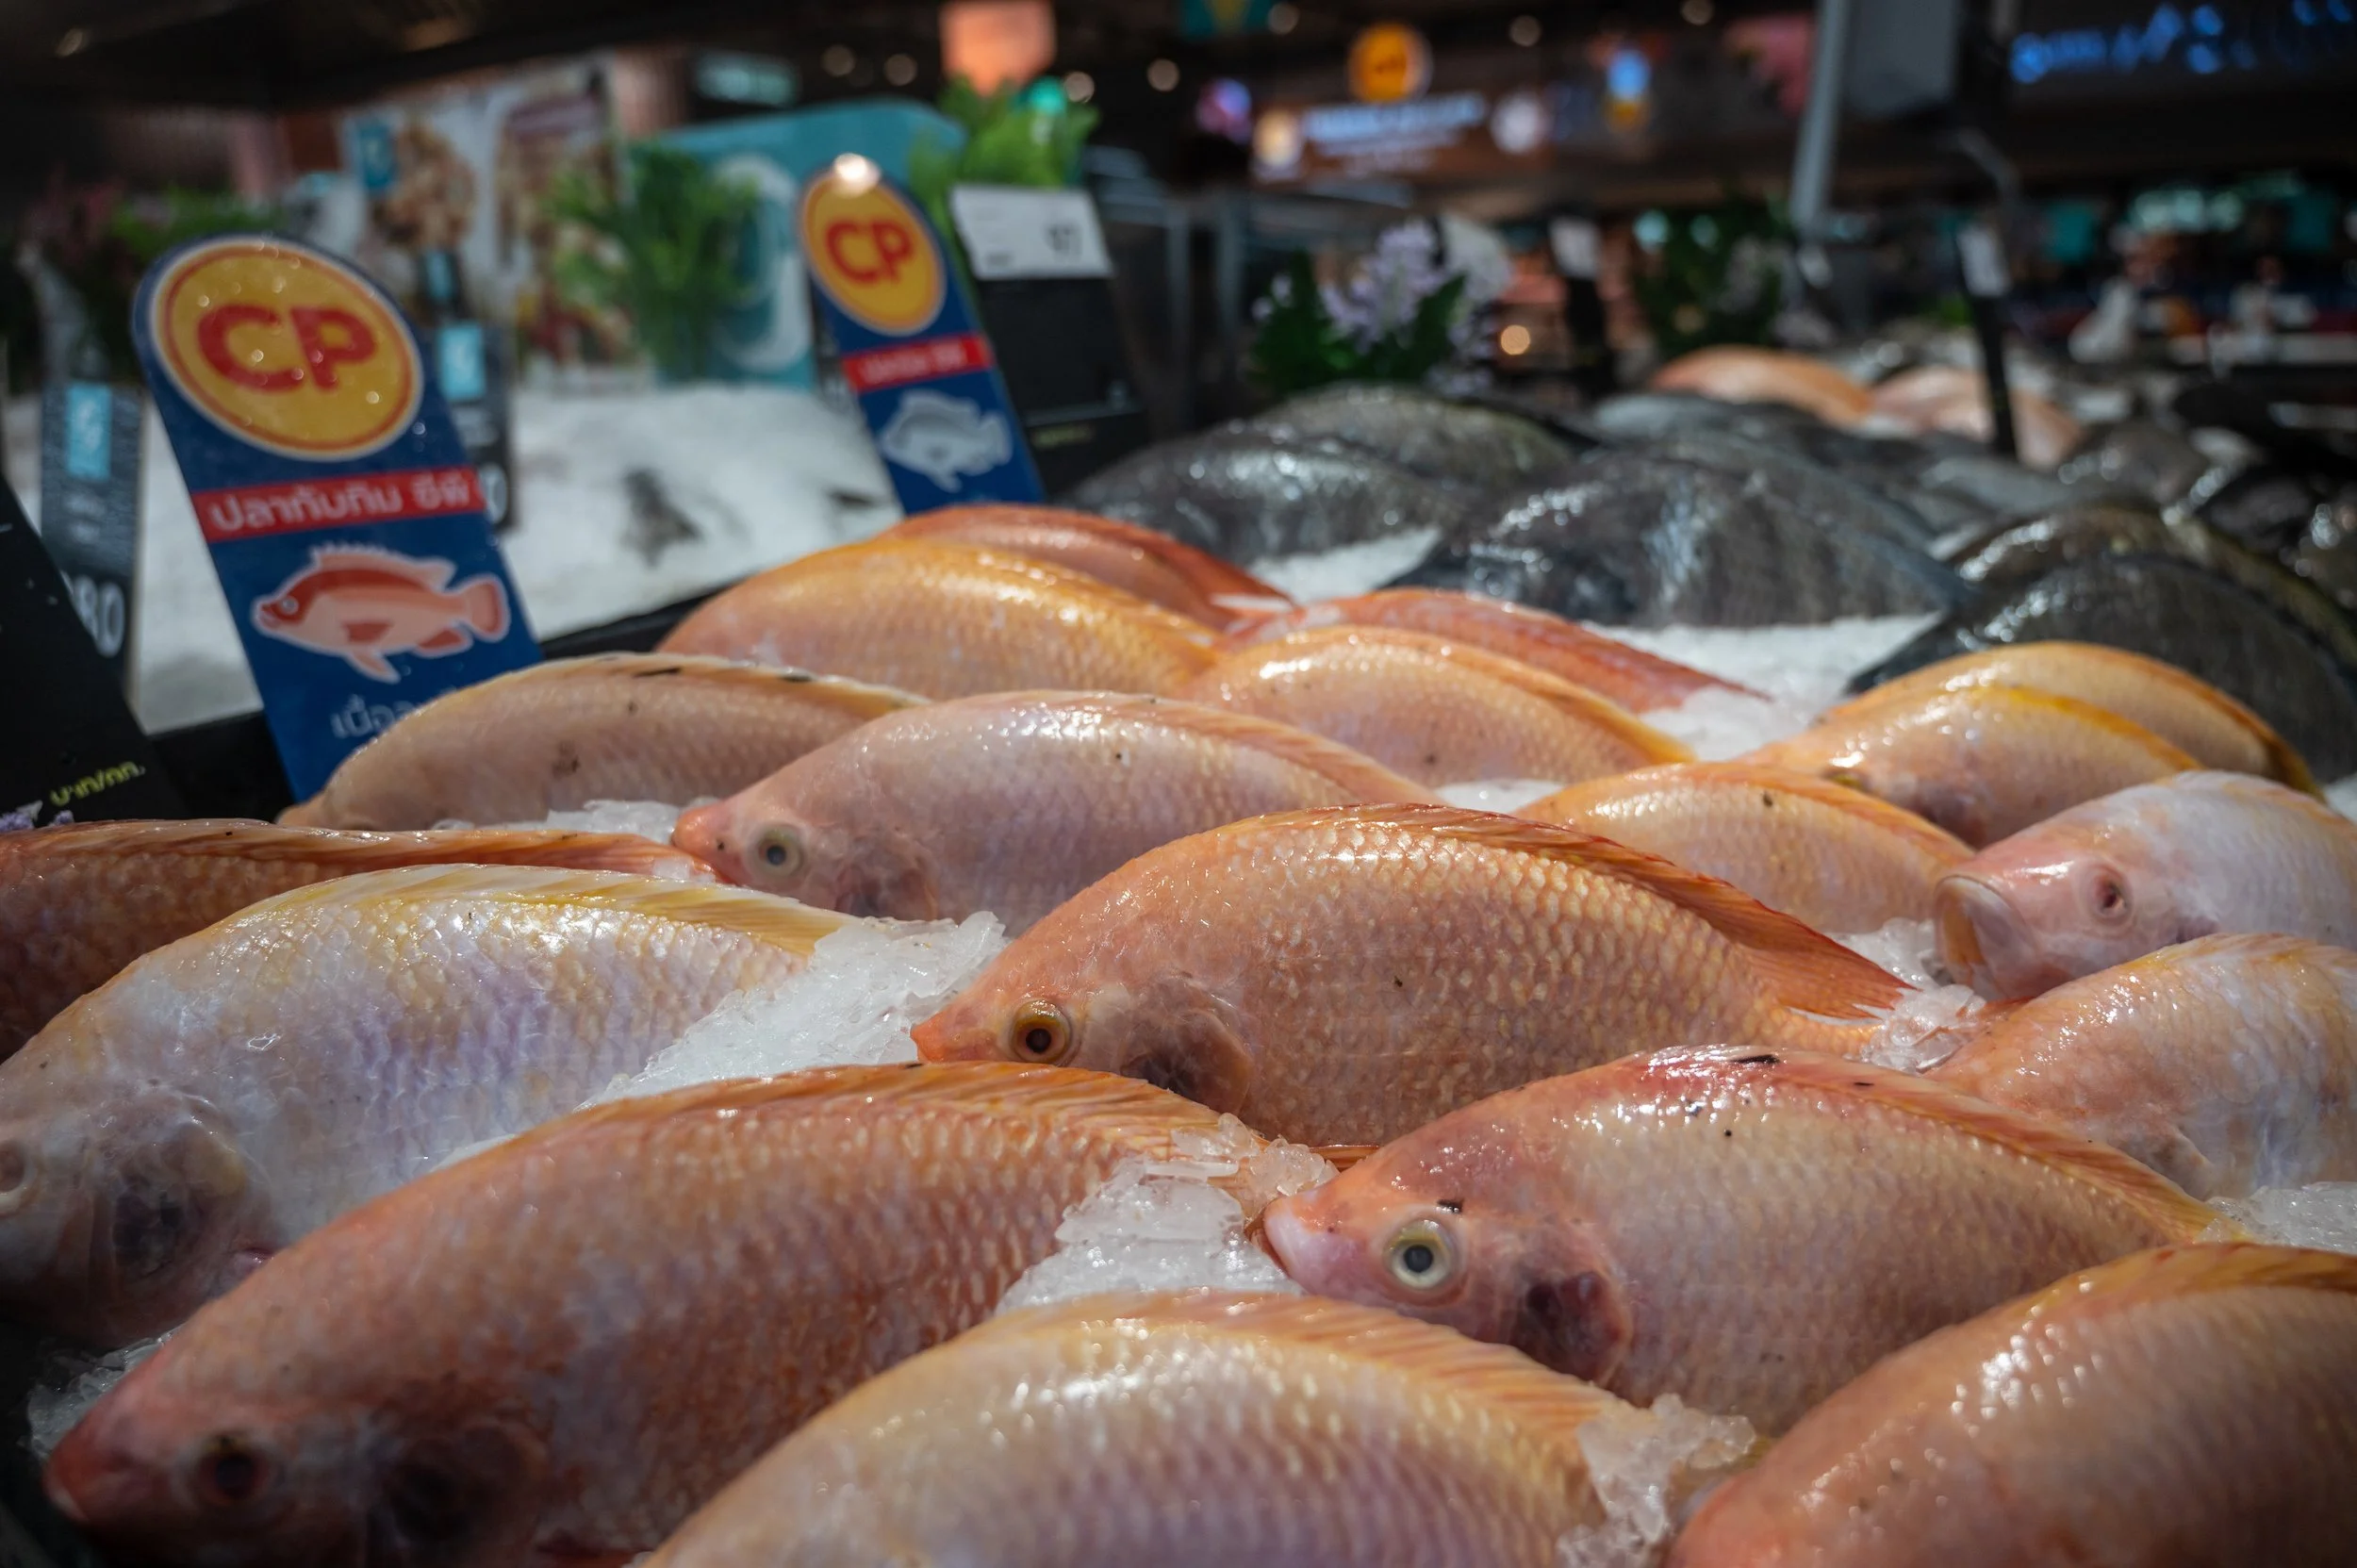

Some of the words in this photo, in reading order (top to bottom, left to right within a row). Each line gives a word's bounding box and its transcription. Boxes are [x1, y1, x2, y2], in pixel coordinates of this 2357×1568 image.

[825, 220, 917, 286] CP
[196, 303, 379, 394] CP
[208, 483, 404, 533] ปลาทับทิม
